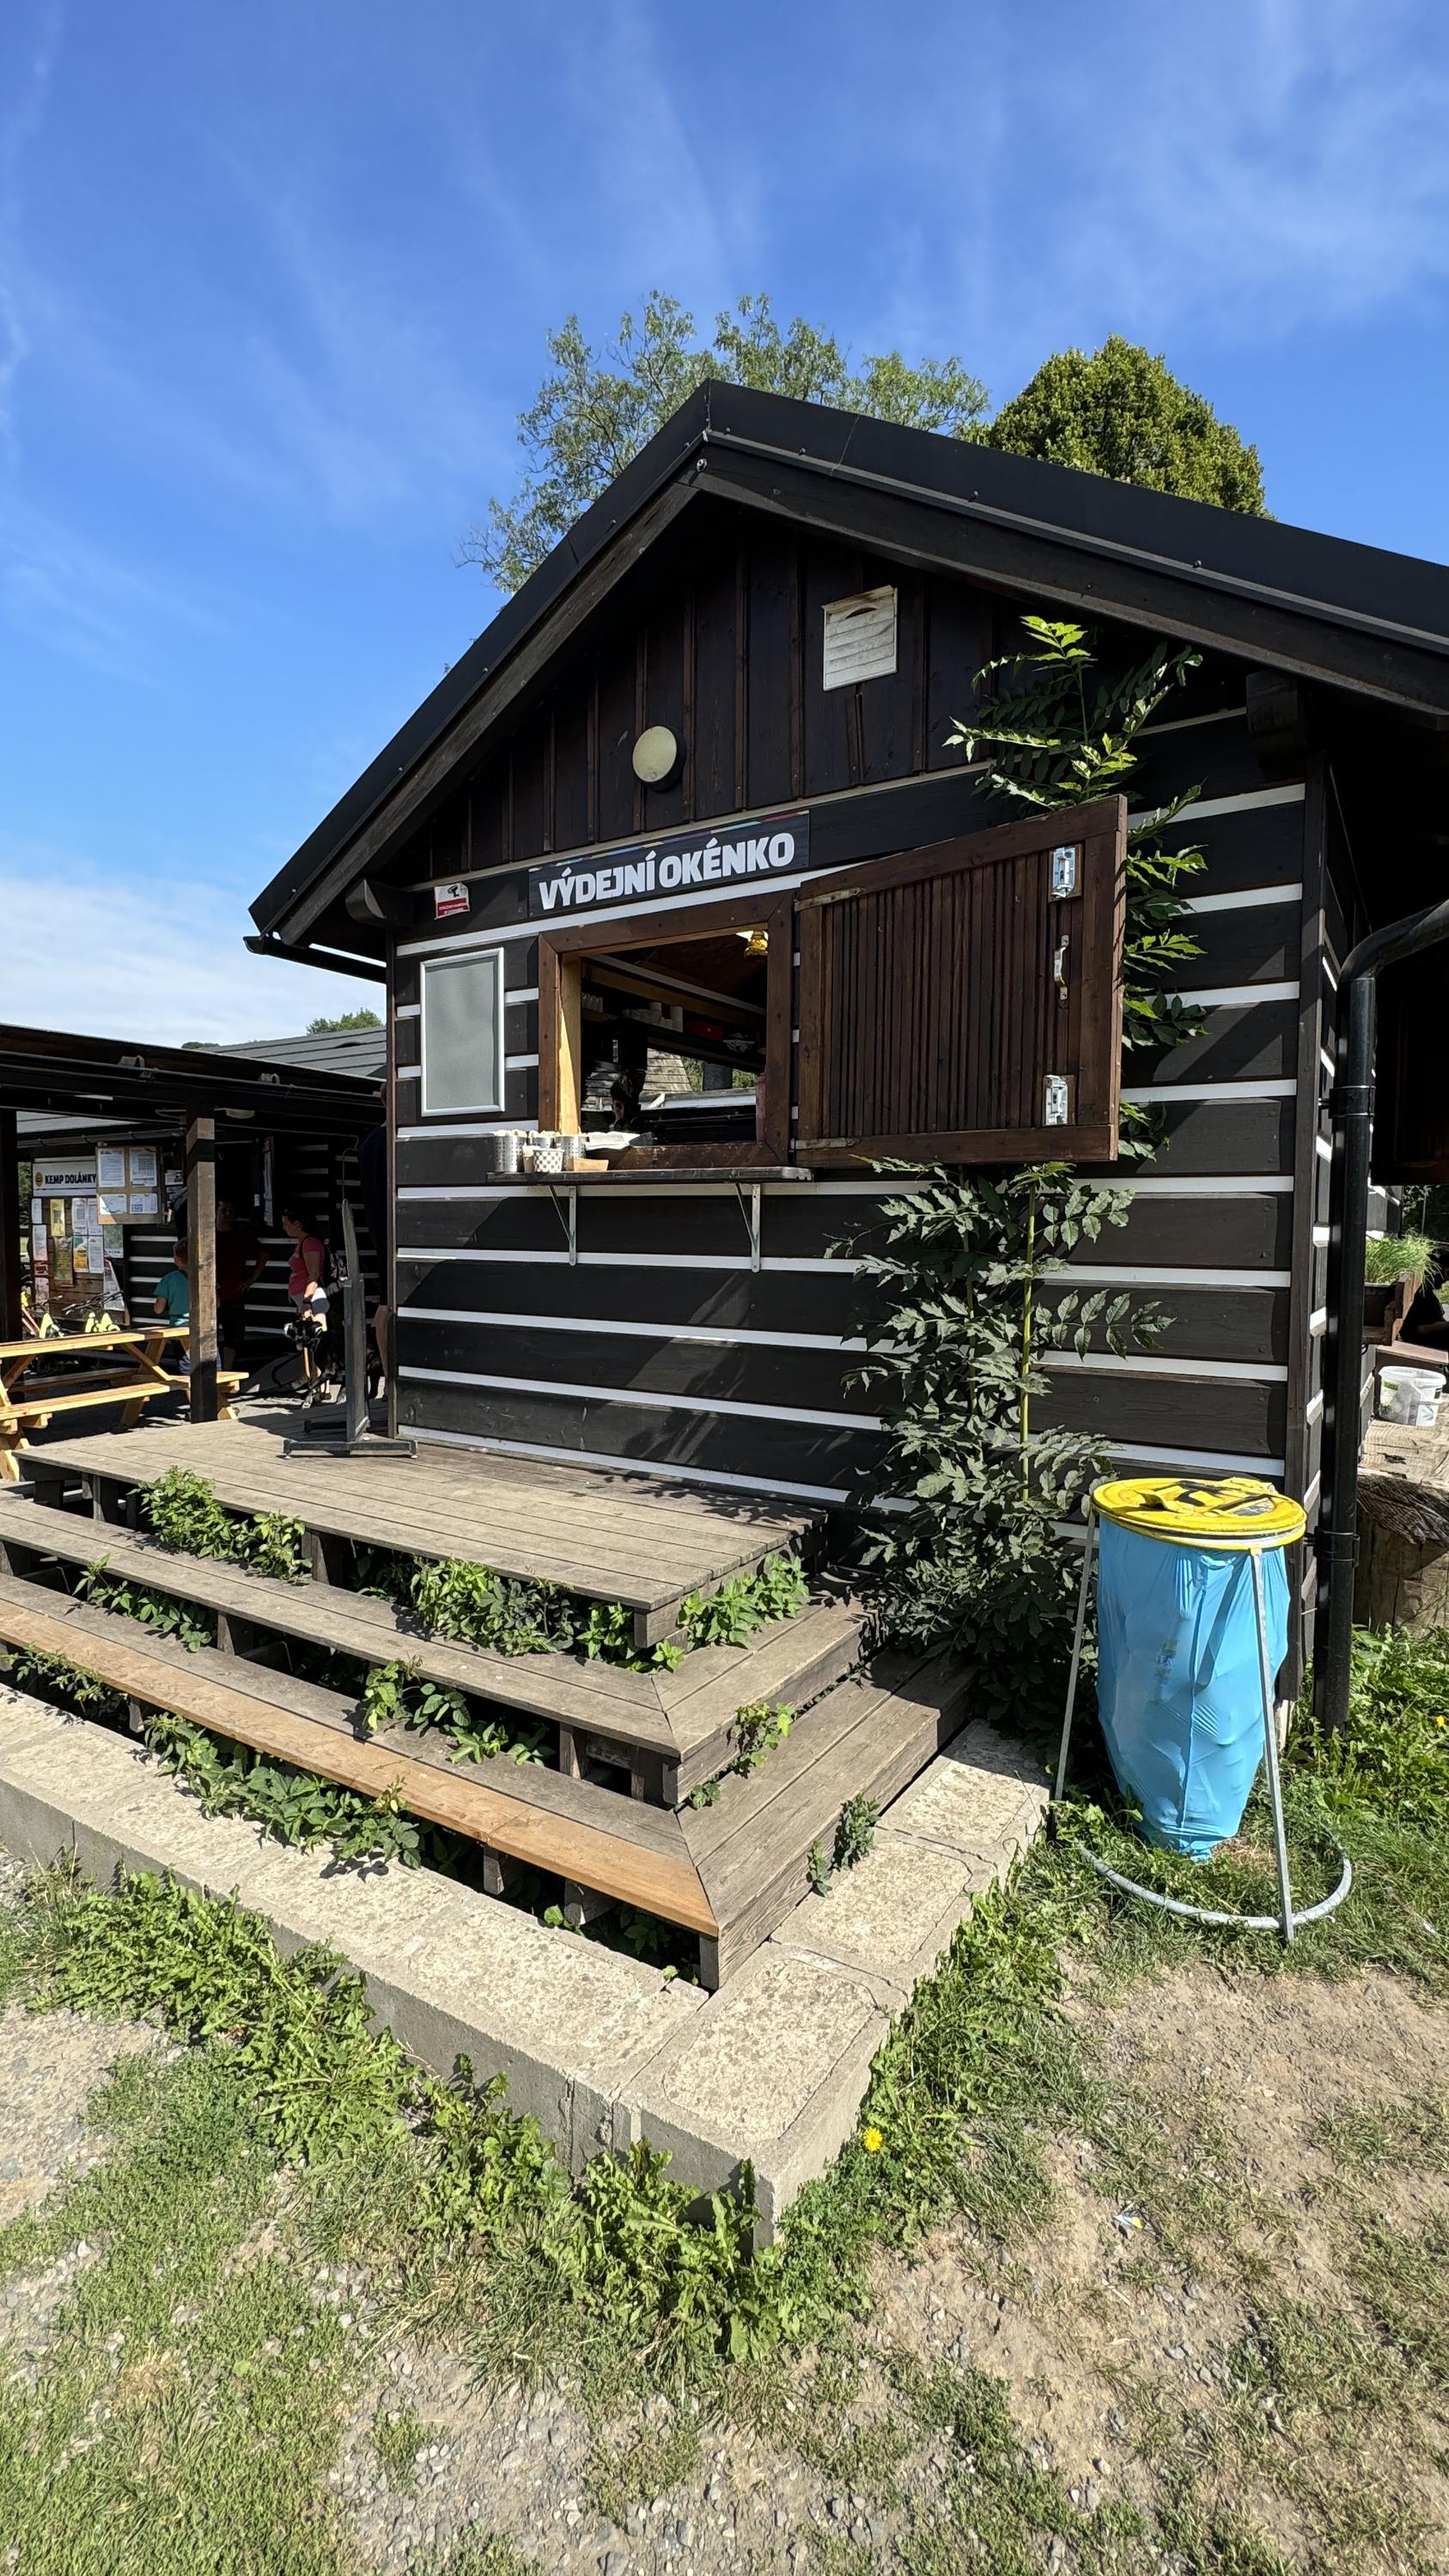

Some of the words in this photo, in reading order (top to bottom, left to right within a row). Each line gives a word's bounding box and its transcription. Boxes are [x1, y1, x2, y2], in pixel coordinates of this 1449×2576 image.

[539, 851, 655, 910] VÝDEJNÍ
[659, 832, 795, 888] OKÉNKO
[45, 1175, 64, 1184] KEMP
[64, 1171, 97, 1184] DOLÁNKY
